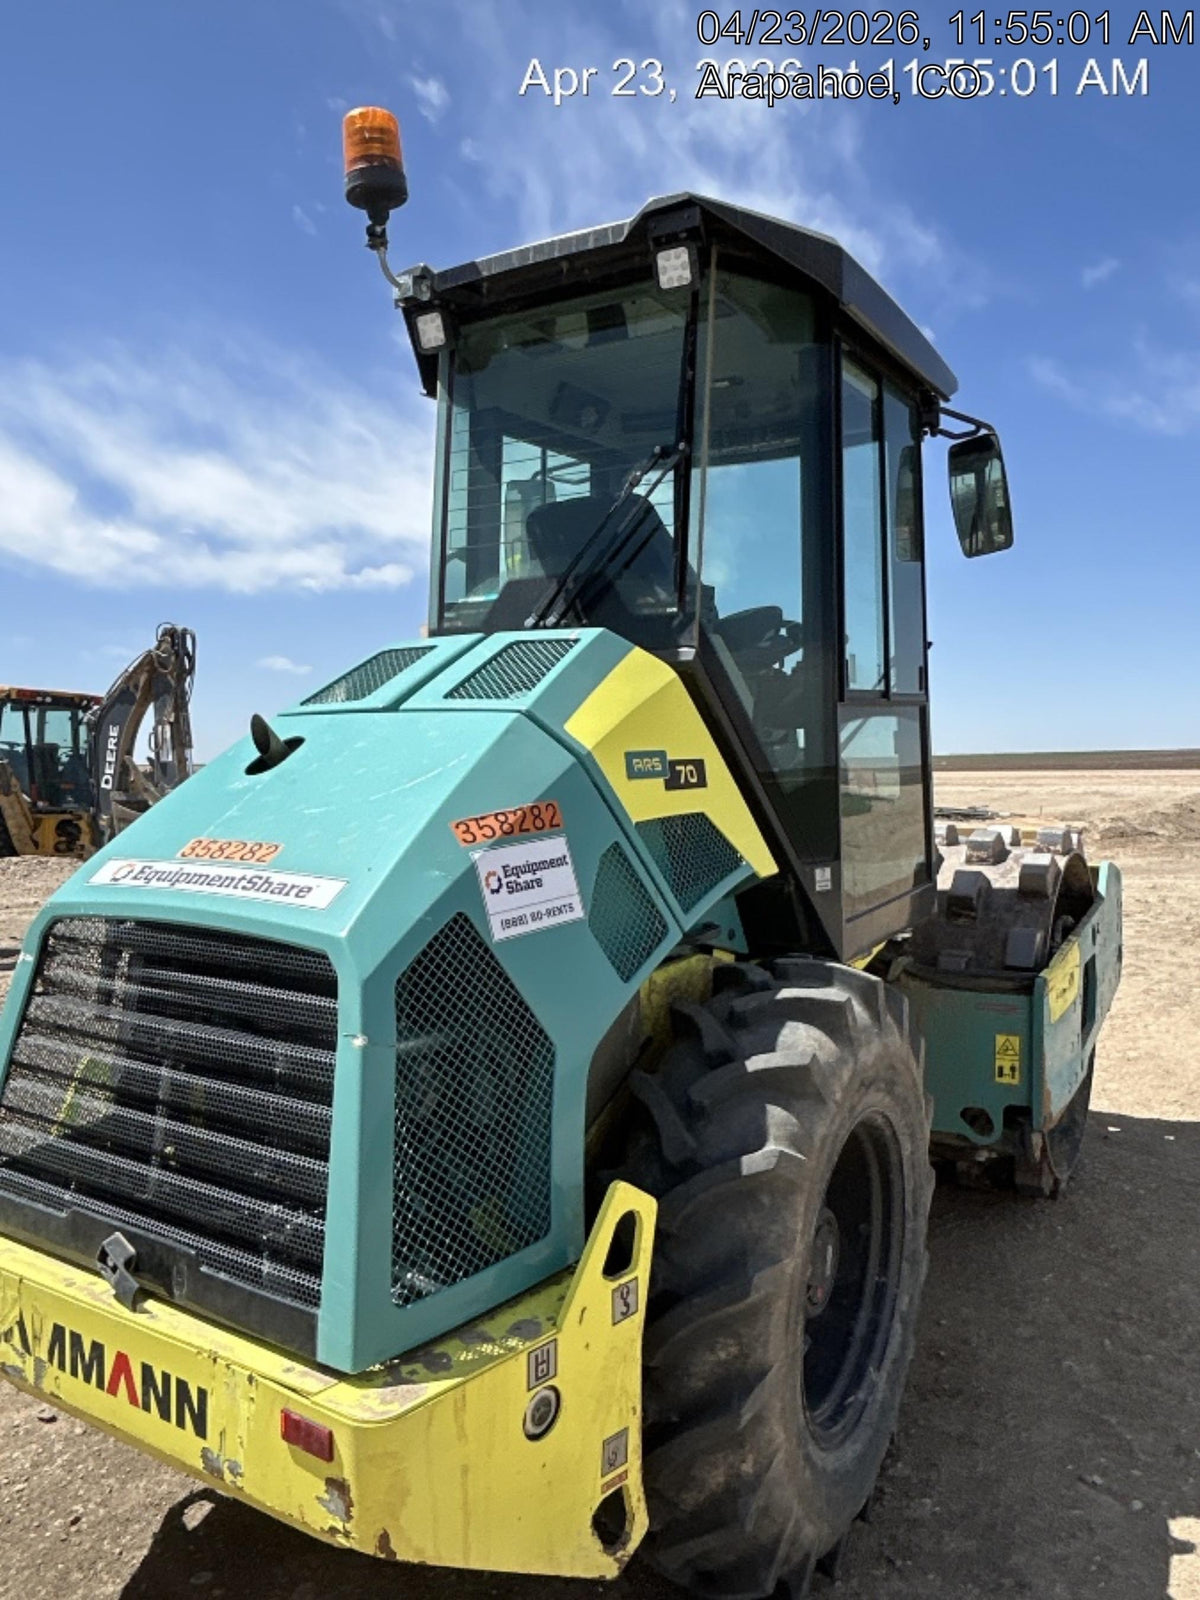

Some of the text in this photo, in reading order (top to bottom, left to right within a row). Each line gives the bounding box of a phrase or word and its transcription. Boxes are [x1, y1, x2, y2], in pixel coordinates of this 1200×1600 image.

[101, 724, 120, 790] DEERE
[632, 757, 698, 784] ARS 70
[454, 802, 561, 844] 358282
[180, 838, 280, 863] 358282
[501, 854, 569, 879] Equipment
[133, 865, 313, 899] EquipmentShare
[505, 876, 544, 895] Share
[500, 914, 529, 931] (888)
